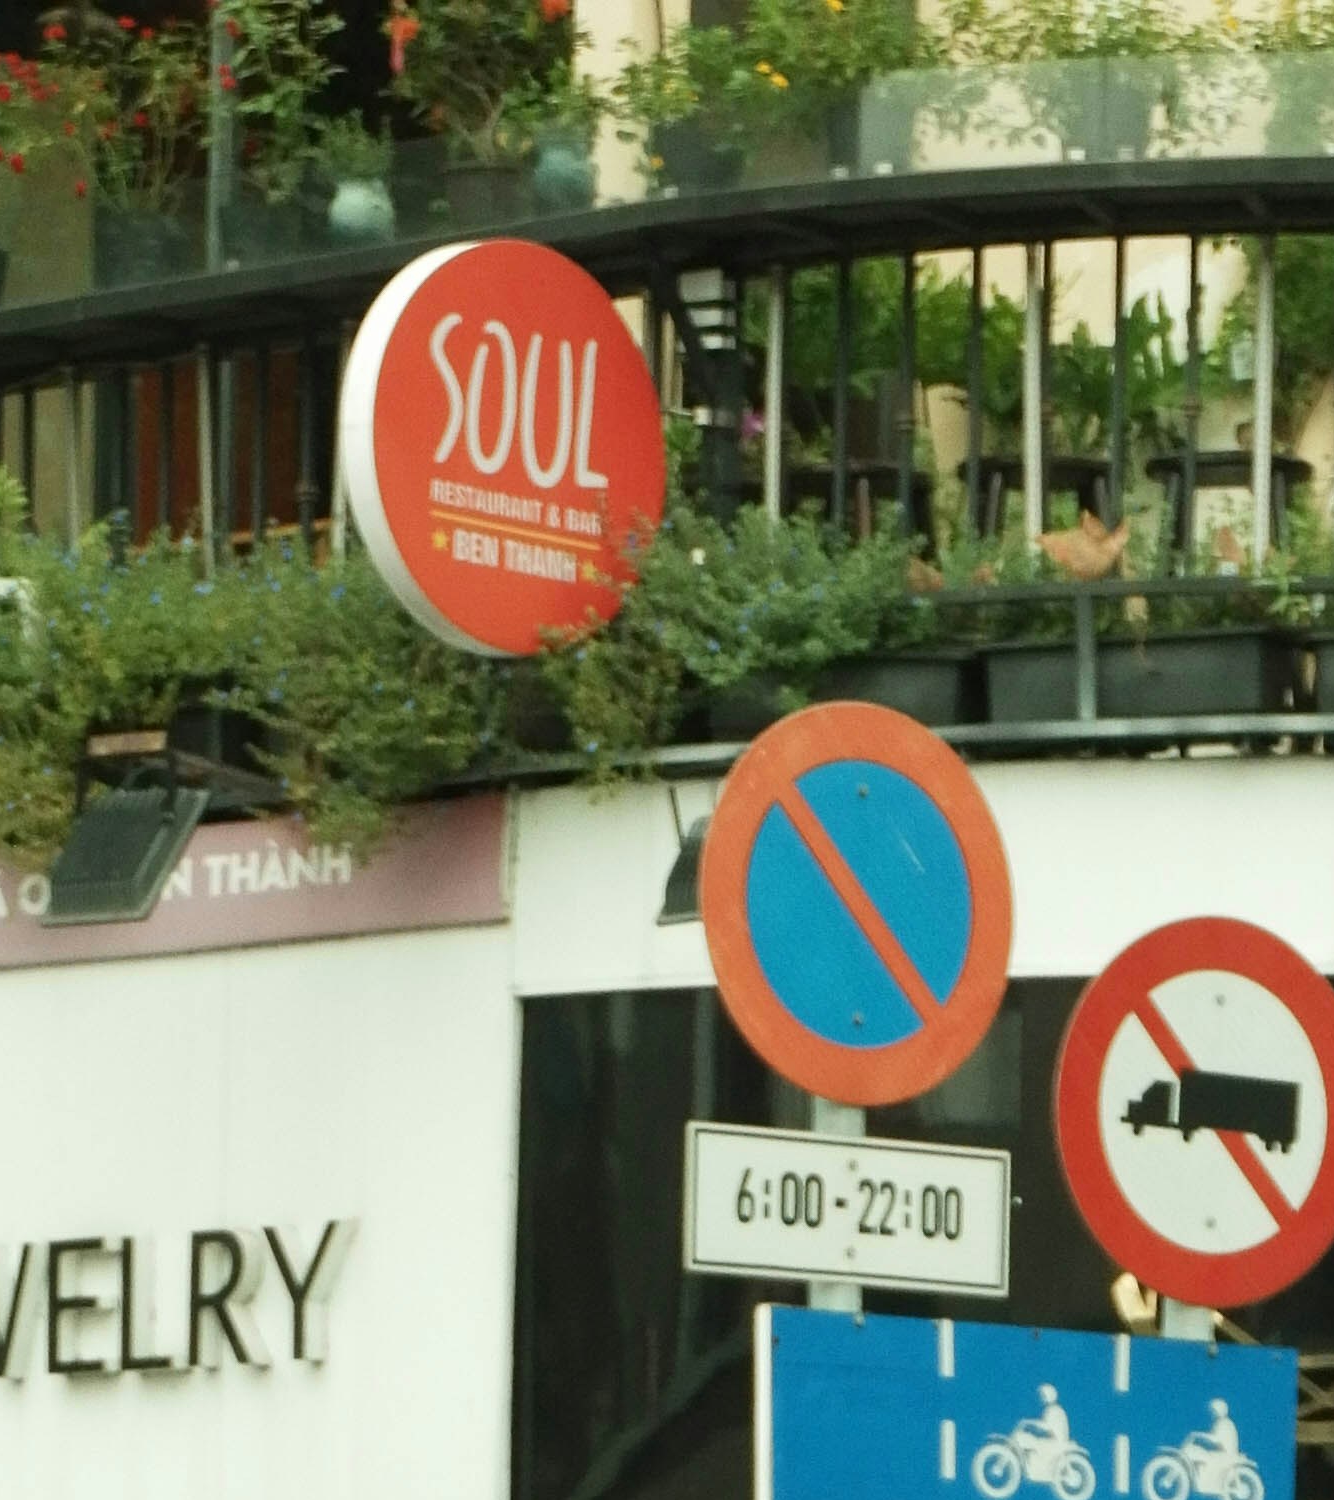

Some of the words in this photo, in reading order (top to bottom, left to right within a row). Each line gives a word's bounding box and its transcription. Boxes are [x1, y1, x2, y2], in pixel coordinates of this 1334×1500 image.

[429, 312, 609, 489] SOUL
[429, 479, 542, 524] RESTAURANT
[546, 504, 561, 530] &
[566, 507, 602, 536] BAR
[452, 529, 499, 568] BEN
[504, 539, 577, 583] THANH
[202, 840, 352, 900] THÀNH
